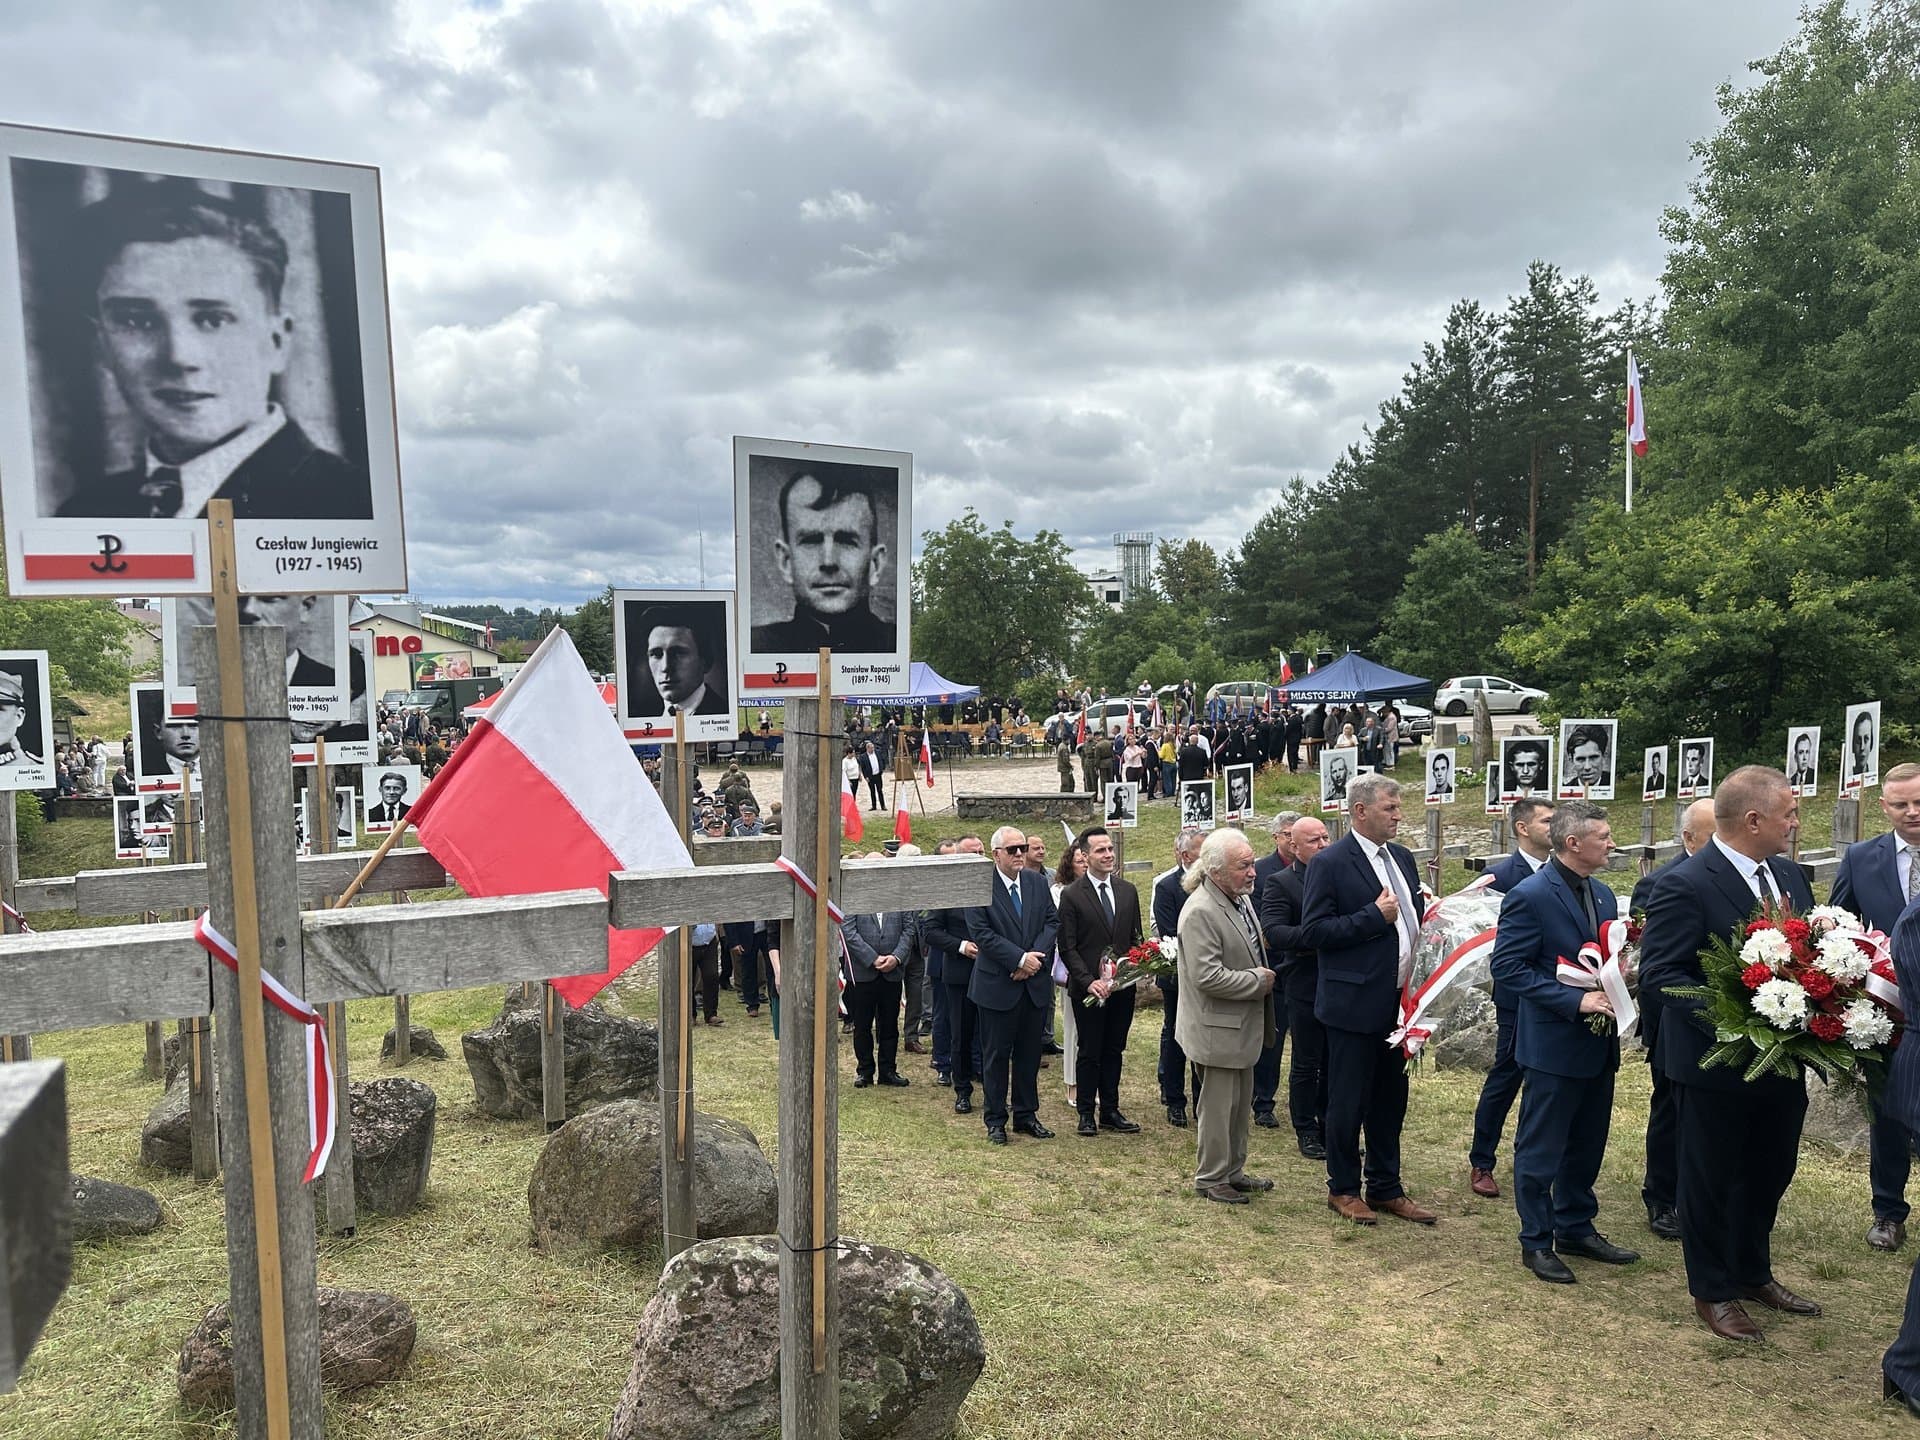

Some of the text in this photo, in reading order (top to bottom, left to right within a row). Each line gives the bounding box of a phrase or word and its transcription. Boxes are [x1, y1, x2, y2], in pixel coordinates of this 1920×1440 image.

[255, 535, 379, 554] Czesław Jungiewicz
[275, 556, 313, 575] (1927
[326, 556, 362, 574] 1945)
[841, 664, 869, 674] Stanisław
[874, 675, 891, 685] 1945)
[288, 695, 339, 703] isław Rutkowski
[1290, 691, 1357, 700] MIASTO SEJNY
[857, 698, 883, 706] GMINA
[288, 703, 305, 712] 1909
[311, 703, 329, 713] 1945)
